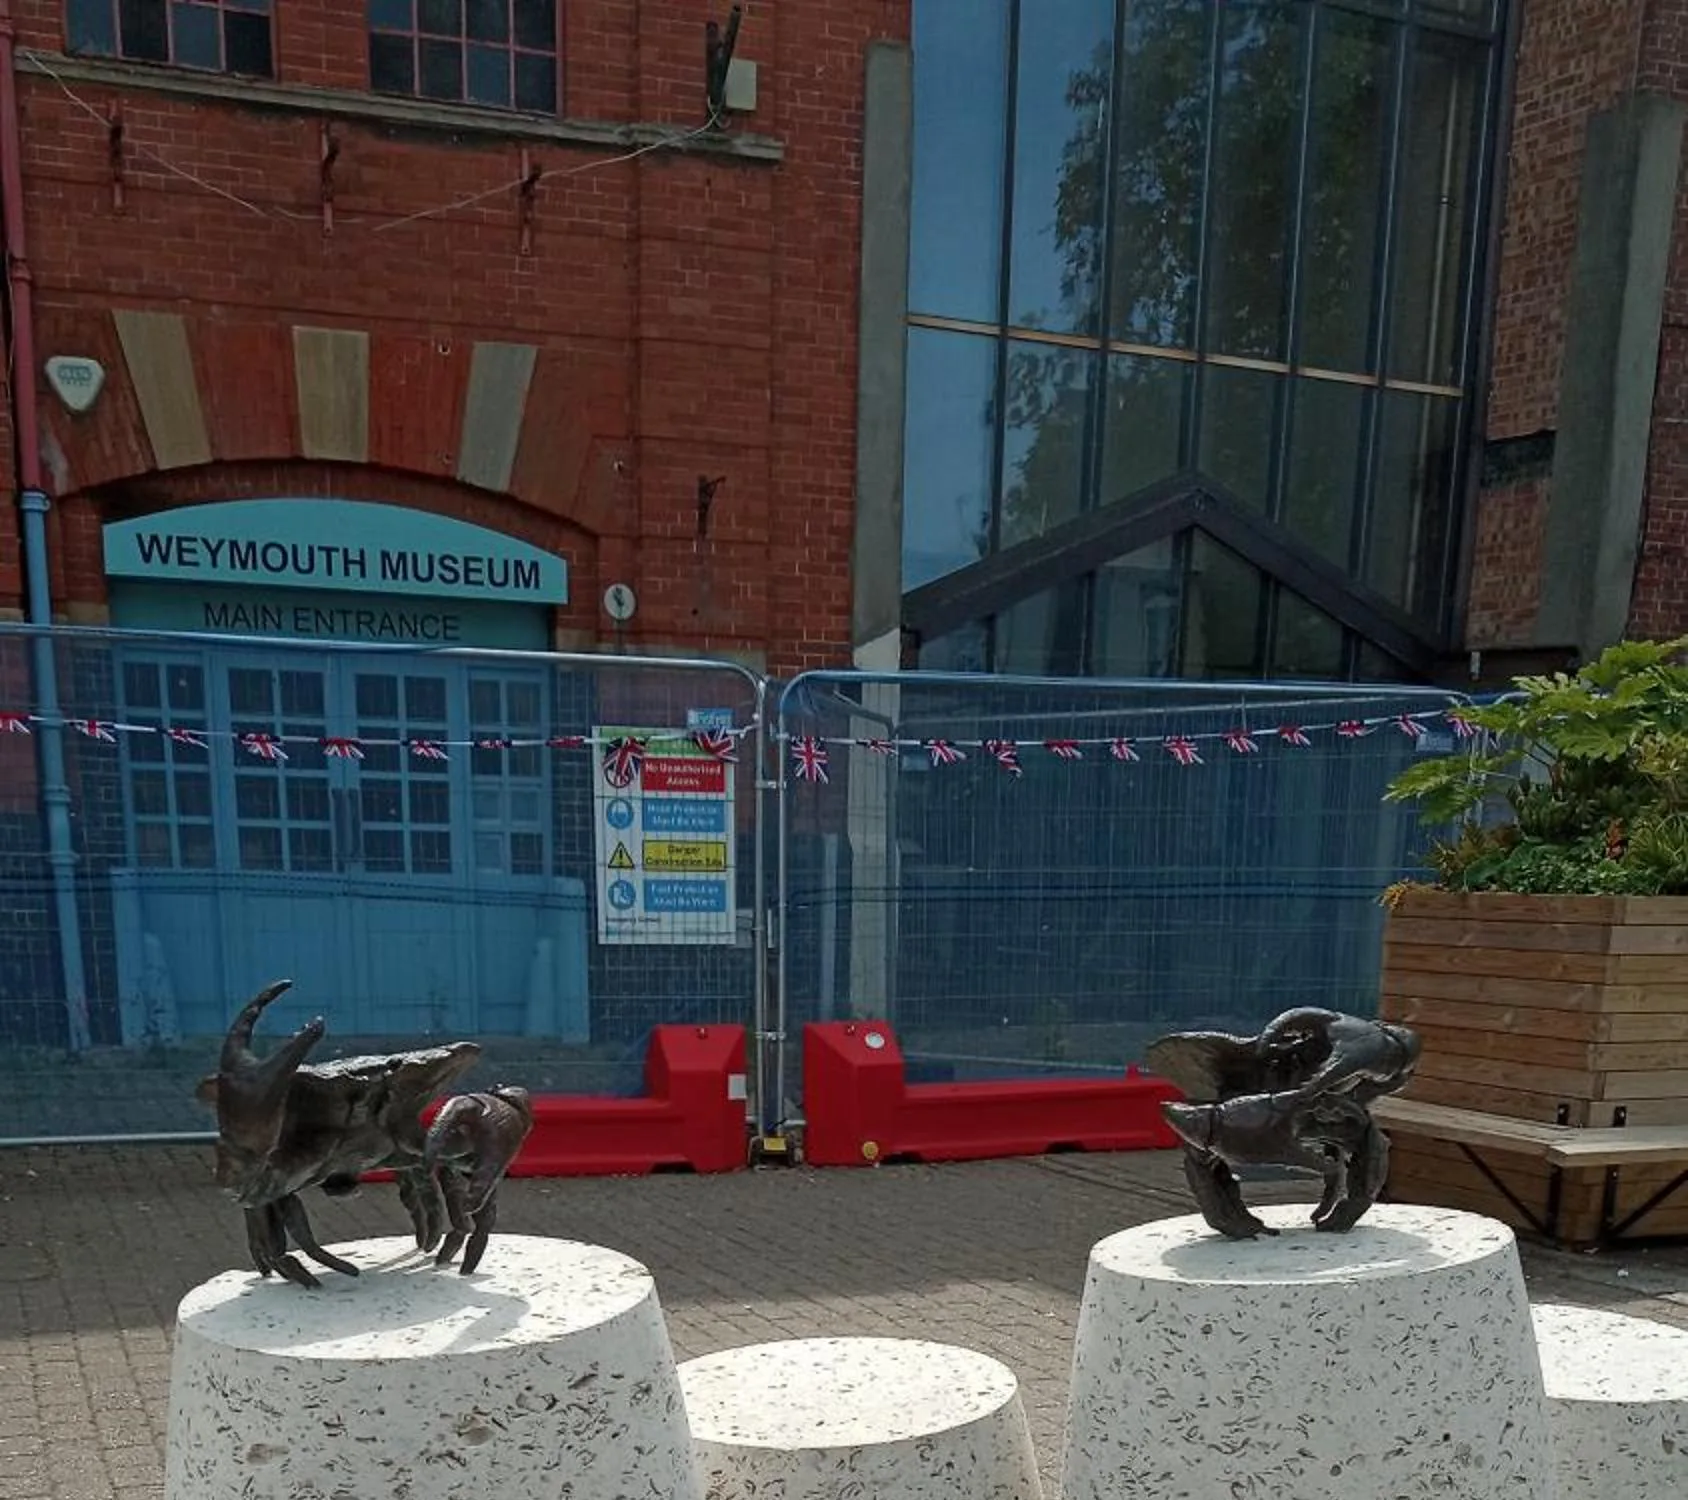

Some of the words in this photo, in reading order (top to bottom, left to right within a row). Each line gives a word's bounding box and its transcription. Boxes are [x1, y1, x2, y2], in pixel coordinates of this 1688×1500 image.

[136, 532, 366, 578] WEYMOUTH
[380, 550, 541, 589] MUSEUM
[204, 602, 282, 631] MAIN
[293, 606, 461, 641] ENTRANCE
[645, 762, 658, 773] No
